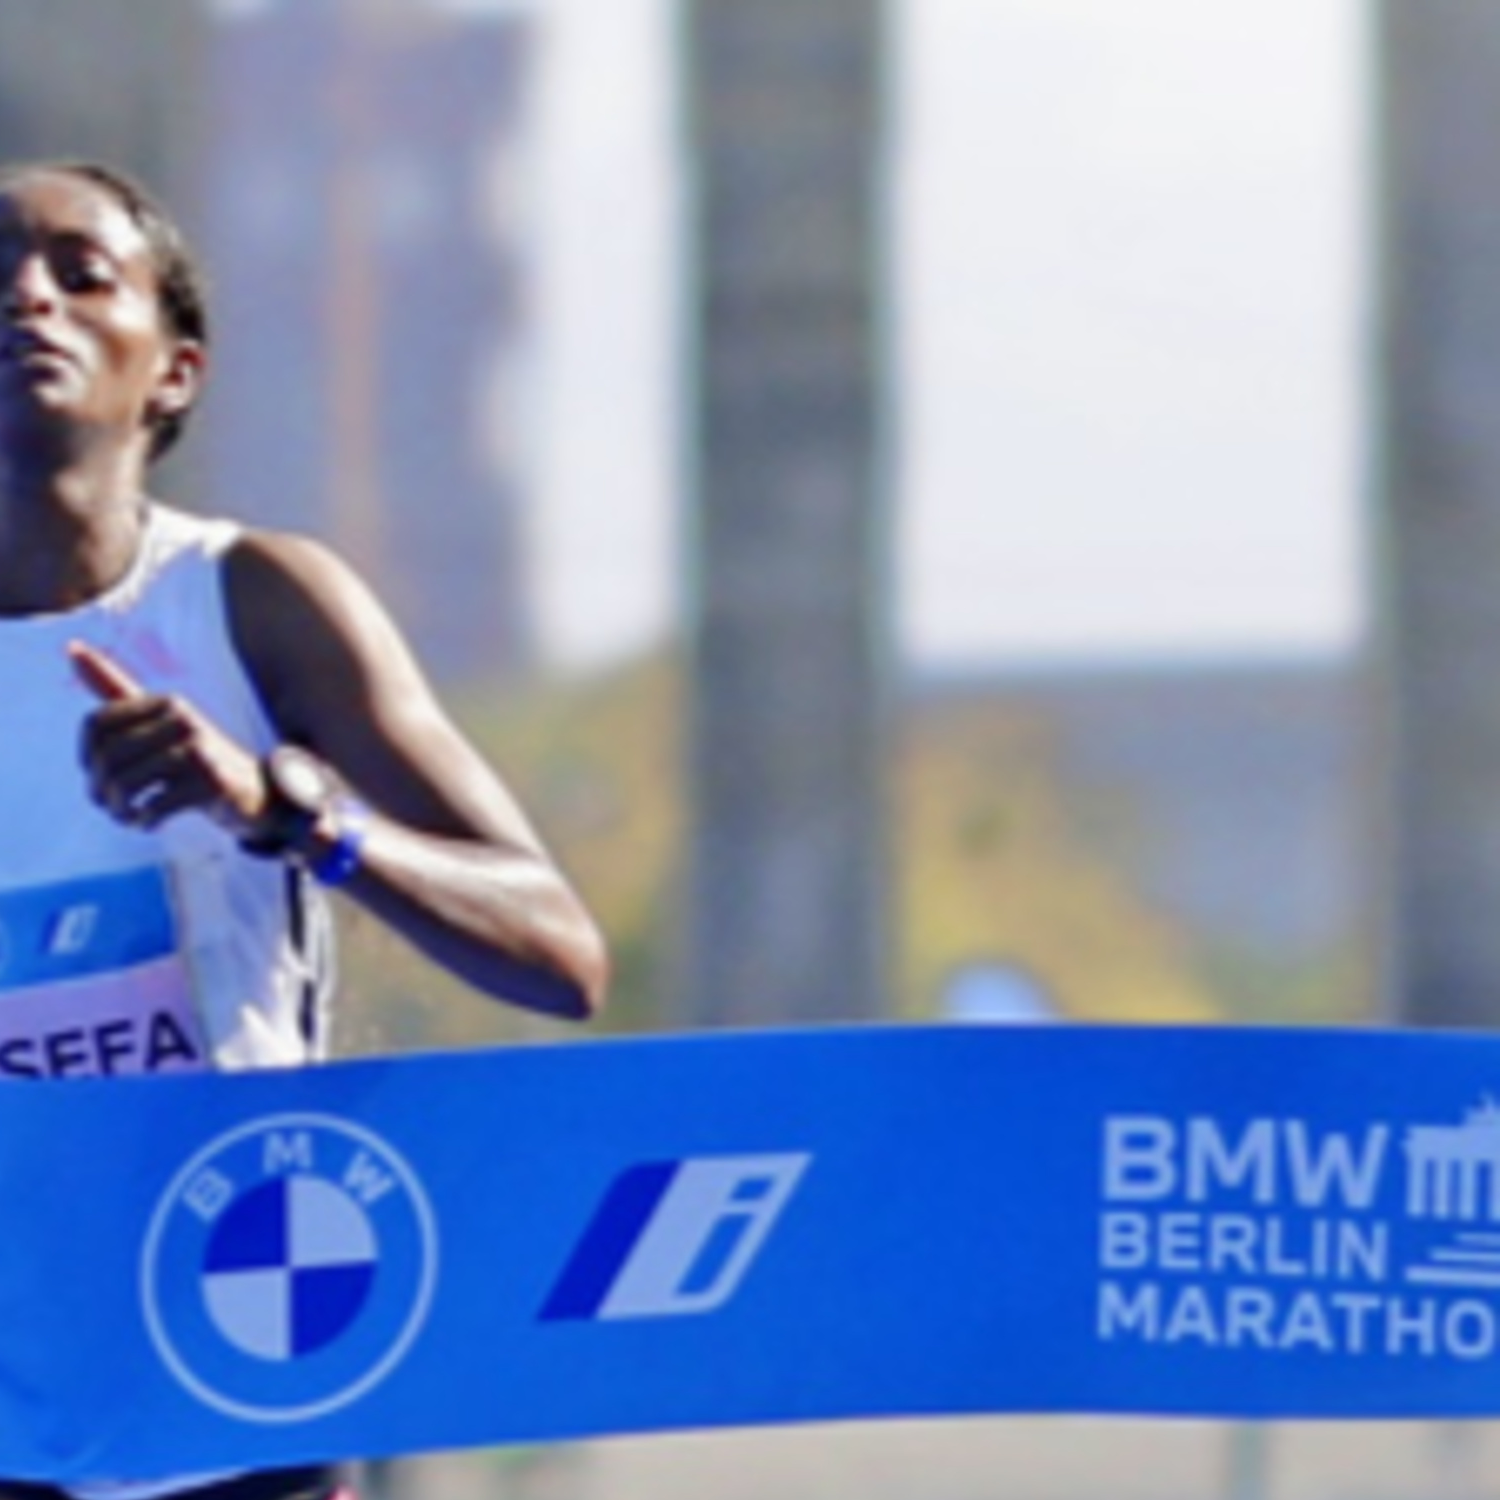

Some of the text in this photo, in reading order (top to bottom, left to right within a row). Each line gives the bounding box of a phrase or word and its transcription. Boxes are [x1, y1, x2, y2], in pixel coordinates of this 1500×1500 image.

[181, 1130, 394, 1222] BMW
[1102, 1115, 1391, 1209] BMW
[1101, 1211, 1389, 1281] BERLIN
[1097, 1281, 1496, 1361] MARATHO
